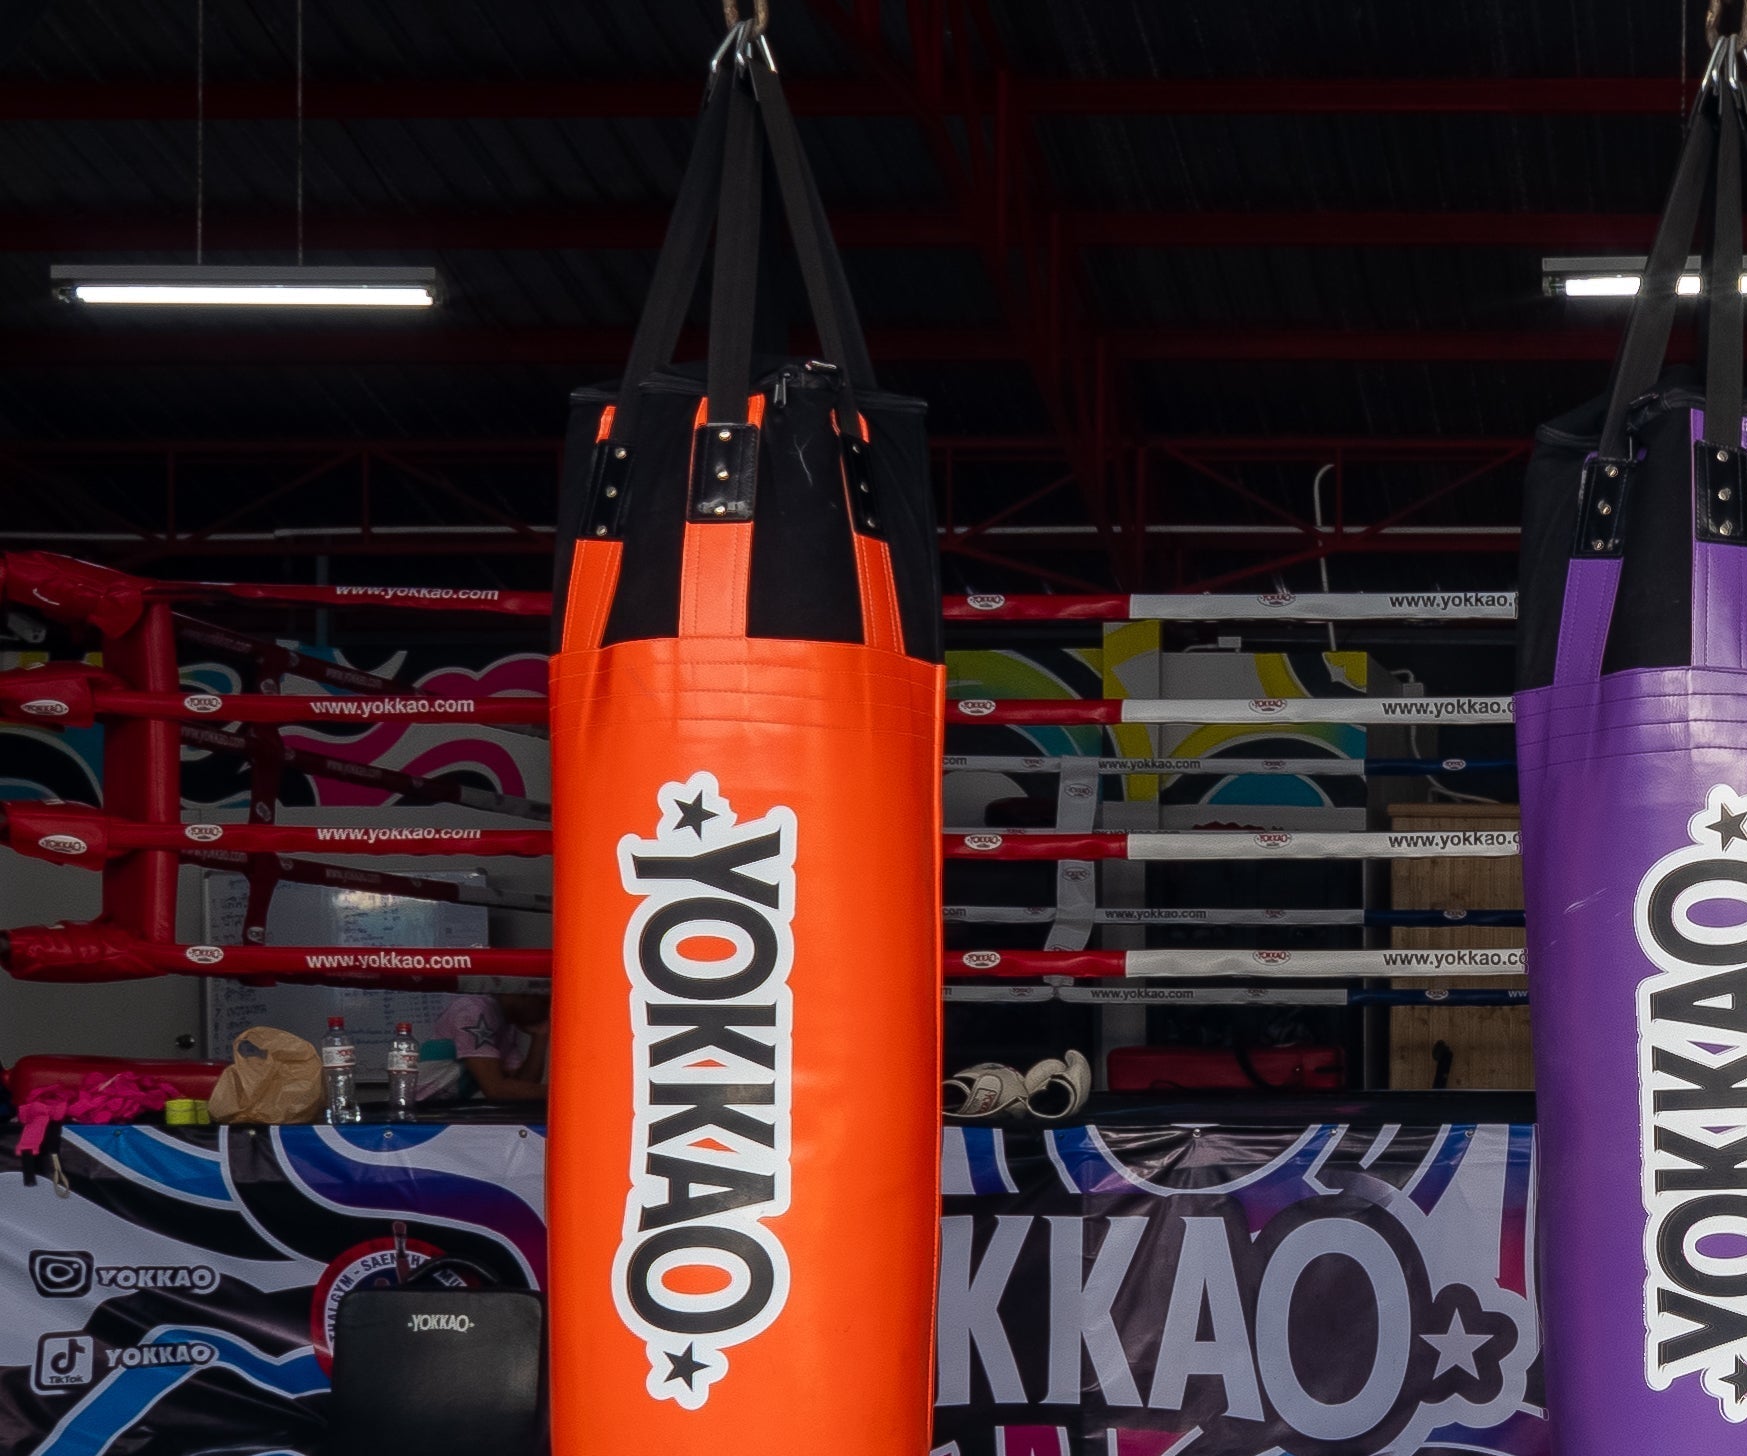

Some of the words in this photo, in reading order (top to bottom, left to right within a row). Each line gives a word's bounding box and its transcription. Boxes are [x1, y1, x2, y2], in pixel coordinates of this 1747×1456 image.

[1390, 593, 1518, 610] www.yokkao.
[310, 697, 475, 718] www.yokkao.com
[1098, 758, 1201, 773] www.yokkao.com
[316, 827, 482, 844] www.yokkao.com
[1105, 908, 1207, 920] www.yokkao.com
[305, 952, 472, 968] www.yokkao.com
[1091, 988, 1194, 1000] www.yokkao.com
[626, 825, 782, 1334] YOKKAO
[99, 1268, 213, 1288] YOKKAO
[411, 1314, 470, 1333] YOKKAO
[934, 1215, 1412, 1441] KKAO
[105, 1346, 211, 1367] YOKKAO
[49, 1375, 84, 1384] TikTok
